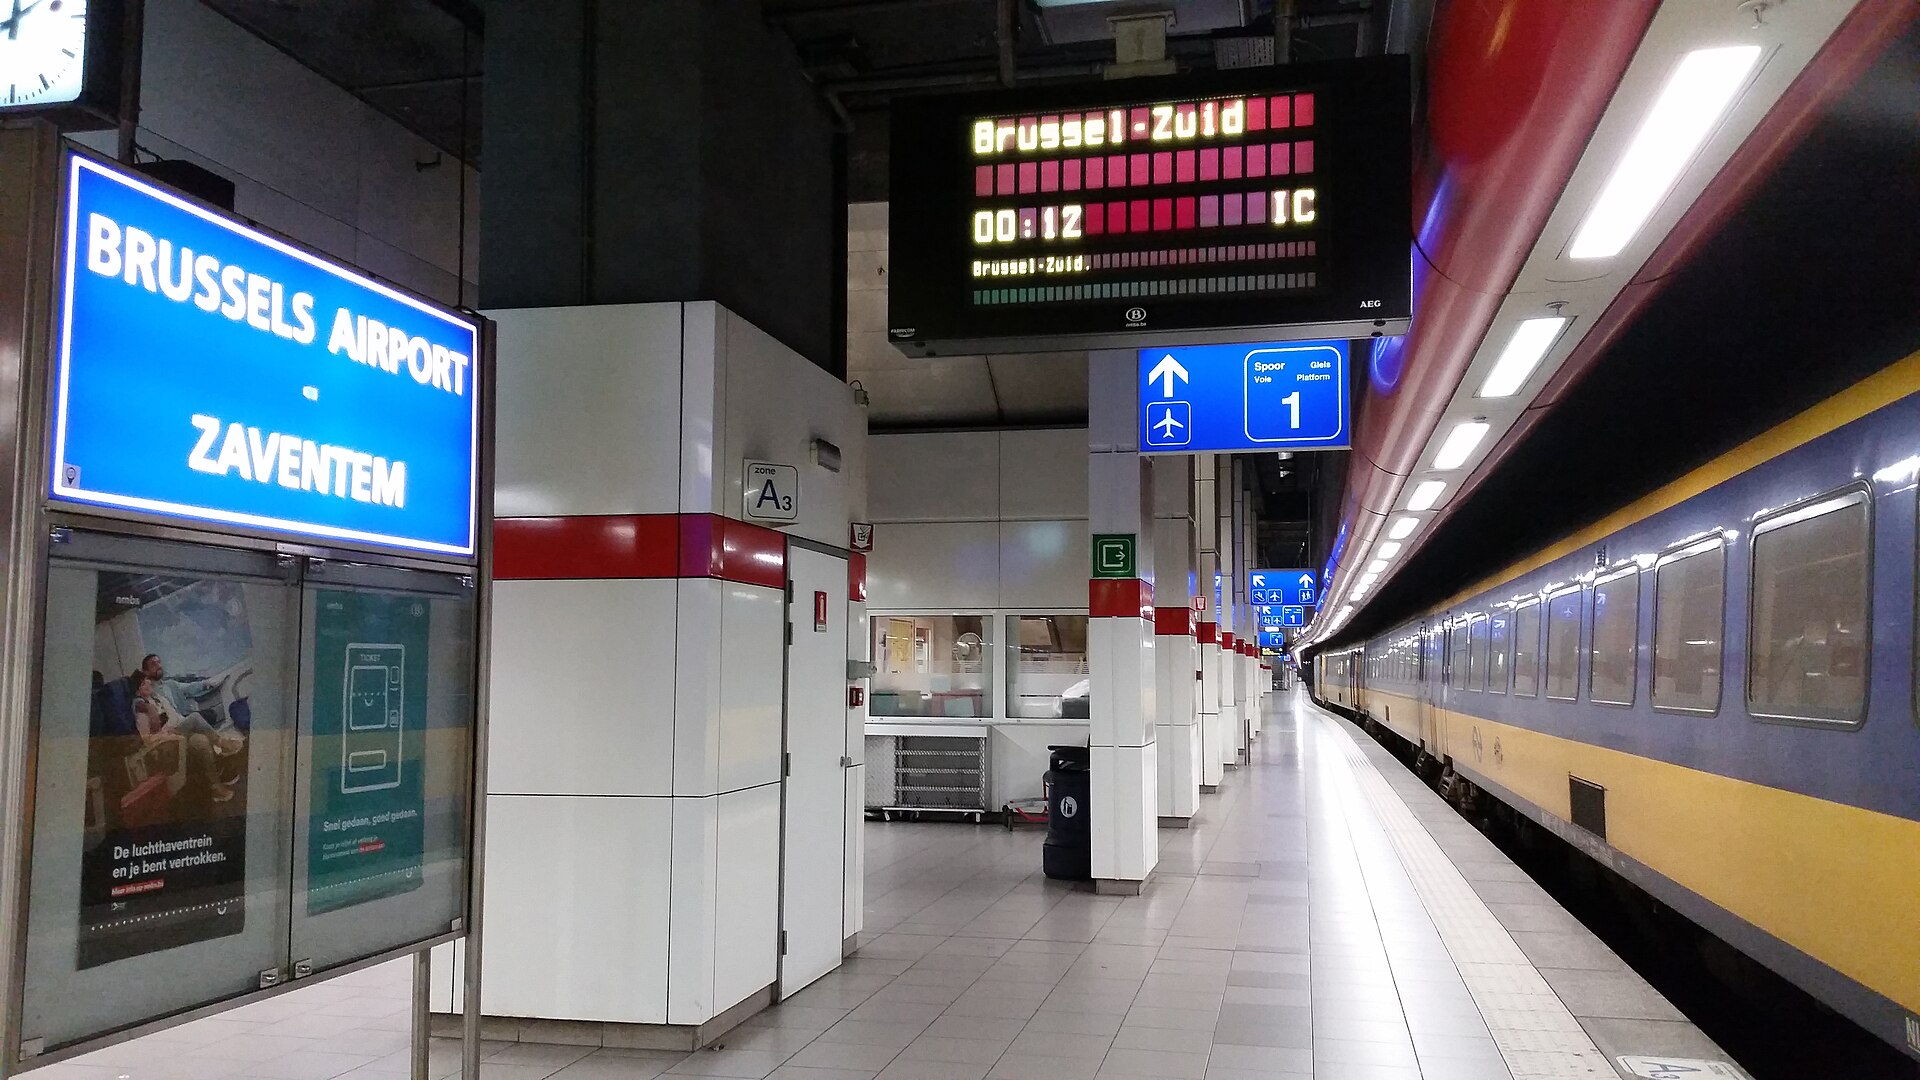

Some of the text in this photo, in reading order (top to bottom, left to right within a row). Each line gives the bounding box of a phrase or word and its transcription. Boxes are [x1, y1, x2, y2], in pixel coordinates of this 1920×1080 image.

[973, 99, 1244, 154] Brussel-Zuid
[1273, 188, 1316, 225] IC
[973, 204, 1082, 243] 00:12
[87, 212, 469, 396] BRUSSELS AIRPORT
[1360, 300, 1381, 308] AEG
[1254, 362, 1285, 372] Spoor
[1310, 361, 1331, 369] Gleis
[1254, 375, 1272, 383] Voie
[1296, 373, 1331, 381] Platform
[1281, 391, 1300, 429] 1
[188, 414, 406, 508] ZAVENTEM
[754, 466, 776, 476] zone
[1290, 614, 1296, 624] 1
[324, 820, 341, 831] Snel
[372, 811, 390, 826] goed
[113, 834, 213, 860] De luchthaventrein
[112, 851, 226, 879] en je bent vertrokken.
